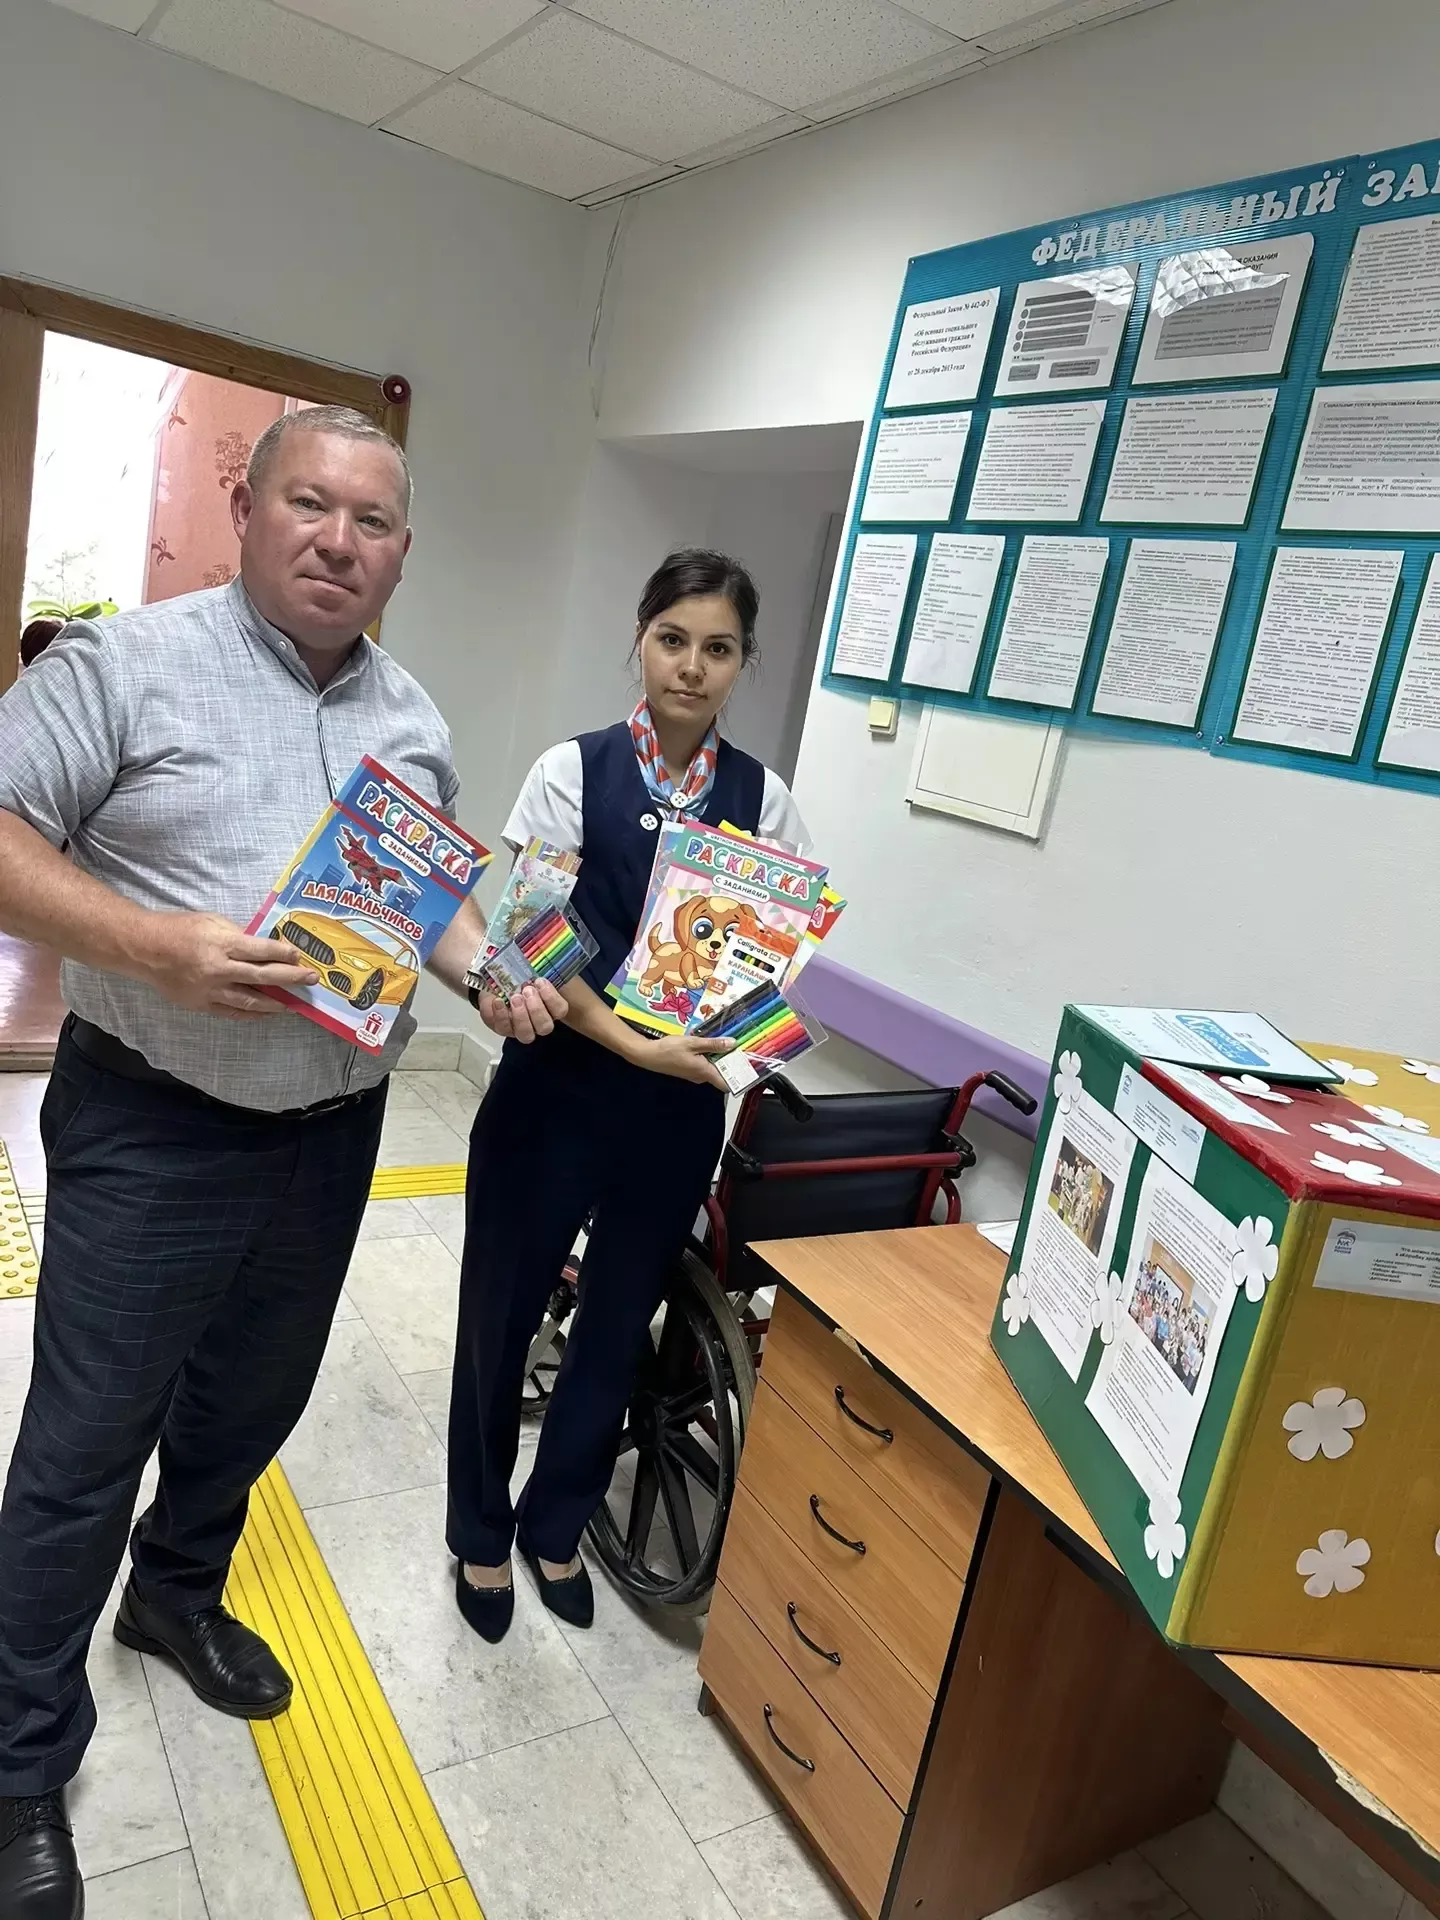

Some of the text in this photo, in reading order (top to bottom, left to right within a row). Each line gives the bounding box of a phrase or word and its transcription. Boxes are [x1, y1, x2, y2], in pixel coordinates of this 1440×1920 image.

[1032, 160, 1440, 266] ФЕДЕРАЛЬНЫЙ ЗА
[913, 308, 946, 319] Федеральный
[947, 305, 963, 314] Закон
[911, 347, 940, 357] Российской
[920, 366, 940, 375] декабря
[941, 364, 954, 373] 2013
[357, 782, 473, 884] РАСКРАСКА
[380, 836, 430, 875] С ЗАДАНИЯМИ
[685, 836, 810, 899] РАСКРАСКА
[723, 879, 768, 901] ЗАДАНИЯМИ
[302, 882, 423, 940] ДЛЯ МАЛЬЧИКОВ
[737, 938, 769, 957] Calligrata
